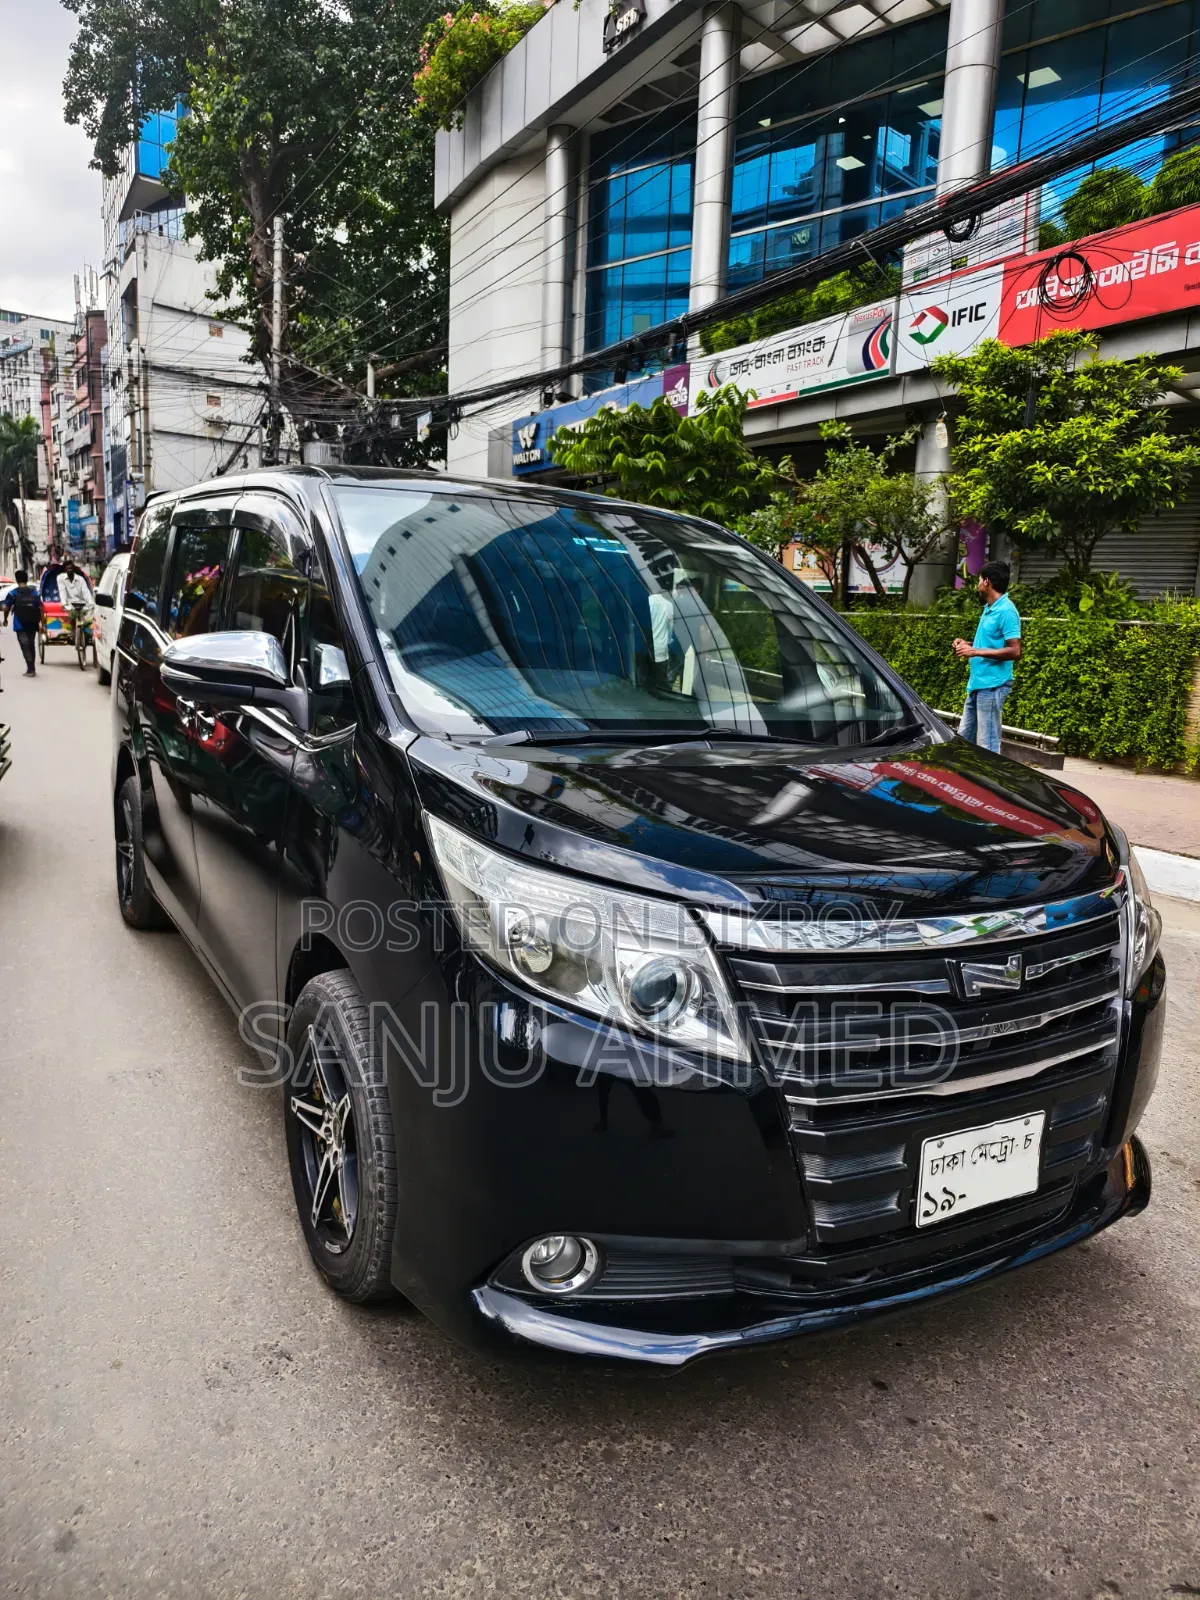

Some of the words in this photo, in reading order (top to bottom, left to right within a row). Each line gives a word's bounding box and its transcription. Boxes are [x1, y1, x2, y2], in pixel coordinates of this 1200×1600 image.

[854, 306, 888, 323] NexusPay
[952, 302, 986, 327] IFIC
[787, 336, 826, 361] ব্যাংক
[786, 362, 802, 374] FAST
[803, 356, 825, 370] TRACK
[513, 448, 541, 466] WALTON
[930, 1150, 966, 1176] ঢাকা
